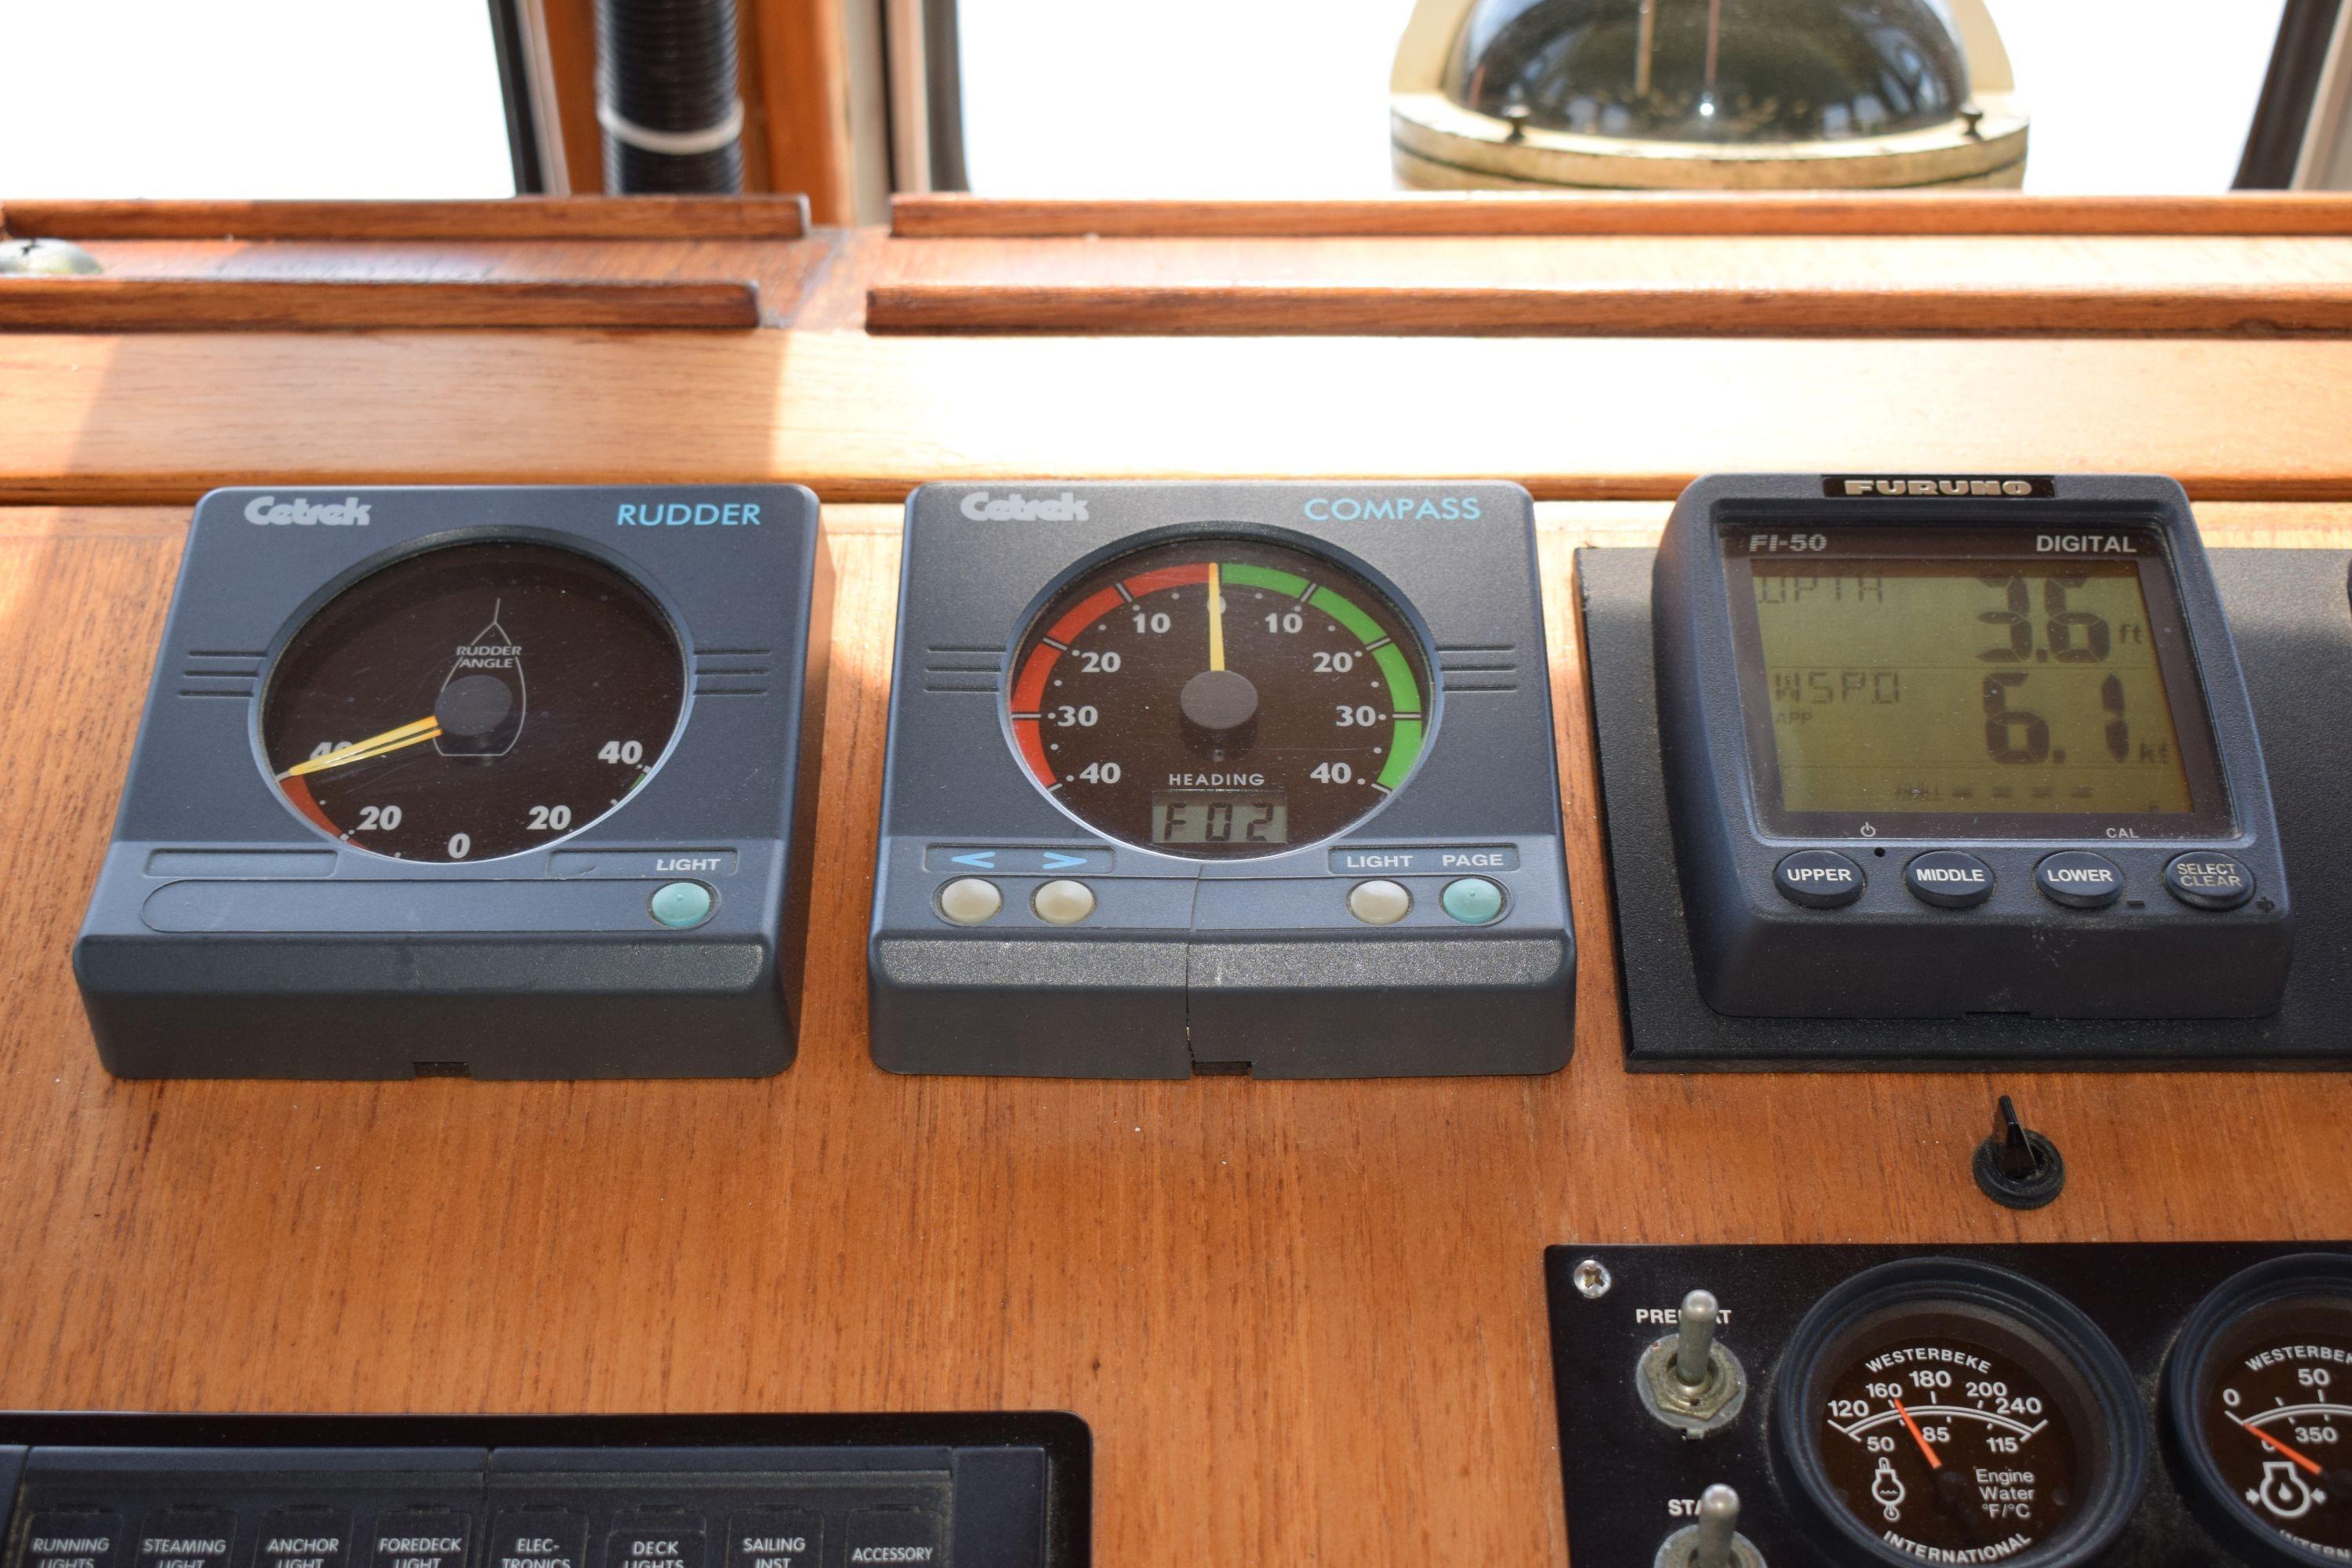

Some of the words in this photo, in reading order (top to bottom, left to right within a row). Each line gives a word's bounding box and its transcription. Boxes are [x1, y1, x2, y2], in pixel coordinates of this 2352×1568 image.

[1846, 480, 2032, 496] FURUNO
[244, 495, 371, 527] Cetrek
[617, 503, 761, 527] RUDDER
[960, 492, 1089, 522] Cetrek
[1304, 497, 1481, 521] COMPASS
[1749, 534, 1828, 552] FI-50
[2036, 535, 2138, 553] DIGITAL
[1133, 612, 1171, 633] 10
[1265, 612, 1303, 633] 10
[1976, 574, 2111, 662] 3.6
[456, 646, 522, 655] RUDDER
[460, 659, 514, 668] ANGLE
[1081, 652, 1121, 673] 20
[1312, 652, 1353, 673] 20
[1057, 706, 1098, 727] 30
[1335, 706, 1376, 727] 30
[1982, 672, 2129, 764] 6.1
[598, 740, 643, 765] 40
[1079, 763, 1121, 784] 40
[1169, 773, 1265, 786] HEADING
[1310, 763, 1352, 784] 40
[357, 805, 402, 830] 20
[526, 805, 572, 830] 20
[2106, 828, 2139, 840] CAL
[448, 833, 470, 858] 0
[656, 858, 720, 871] LIGHT
[1347, 855, 1413, 868] LIGHT
[1442, 854, 1504, 867] PAGE
[2177, 862, 2236, 875] SELECT
[1787, 868, 1852, 882] UPPER
[1916, 868, 1985, 882] MIDDLE
[2047, 869, 2113, 882] LOWER
[2180, 873, 2243, 887] CLEAR
[1635, 1308, 1732, 1324] PRET
[1865, 1348, 1991, 1373] WESTERBEKE
[1909, 1370, 1951, 1388] 180
[2298, 1368, 2331, 1386] 50
[1865, 1382, 1902, 1398] 160
[1965, 1382, 2007, 1398] 200
[2223, 1388, 2241, 1406] 0
[1828, 1399, 1869, 1417] 120
[1994, 1397, 2042, 1414] 240
[1922, 1427, 1951, 1442] 85
[2295, 1427, 2338, 1443] 350
[1867, 1436, 1895, 1451] 50
[1986, 1437, 2018, 1451] 115
[1976, 1468, 2034, 1485] Engine
[1980, 1486, 2035, 1501] Water
[32, 1537, 110, 1552] RUNNING
[142, 1538, 227, 1554] STEAMING
[267, 1538, 339, 1552] ANCHOR
[379, 1537, 463, 1552] FOREDECK
[517, 1538, 560, 1552] ELEC-
[632, 1541, 679, 1555] DECK
[742, 1537, 806, 1553] SAILING
[1882, 1530, 2033, 1563] INTERNATIONAL
[851, 1547, 933, 1563] ACCESSORY
